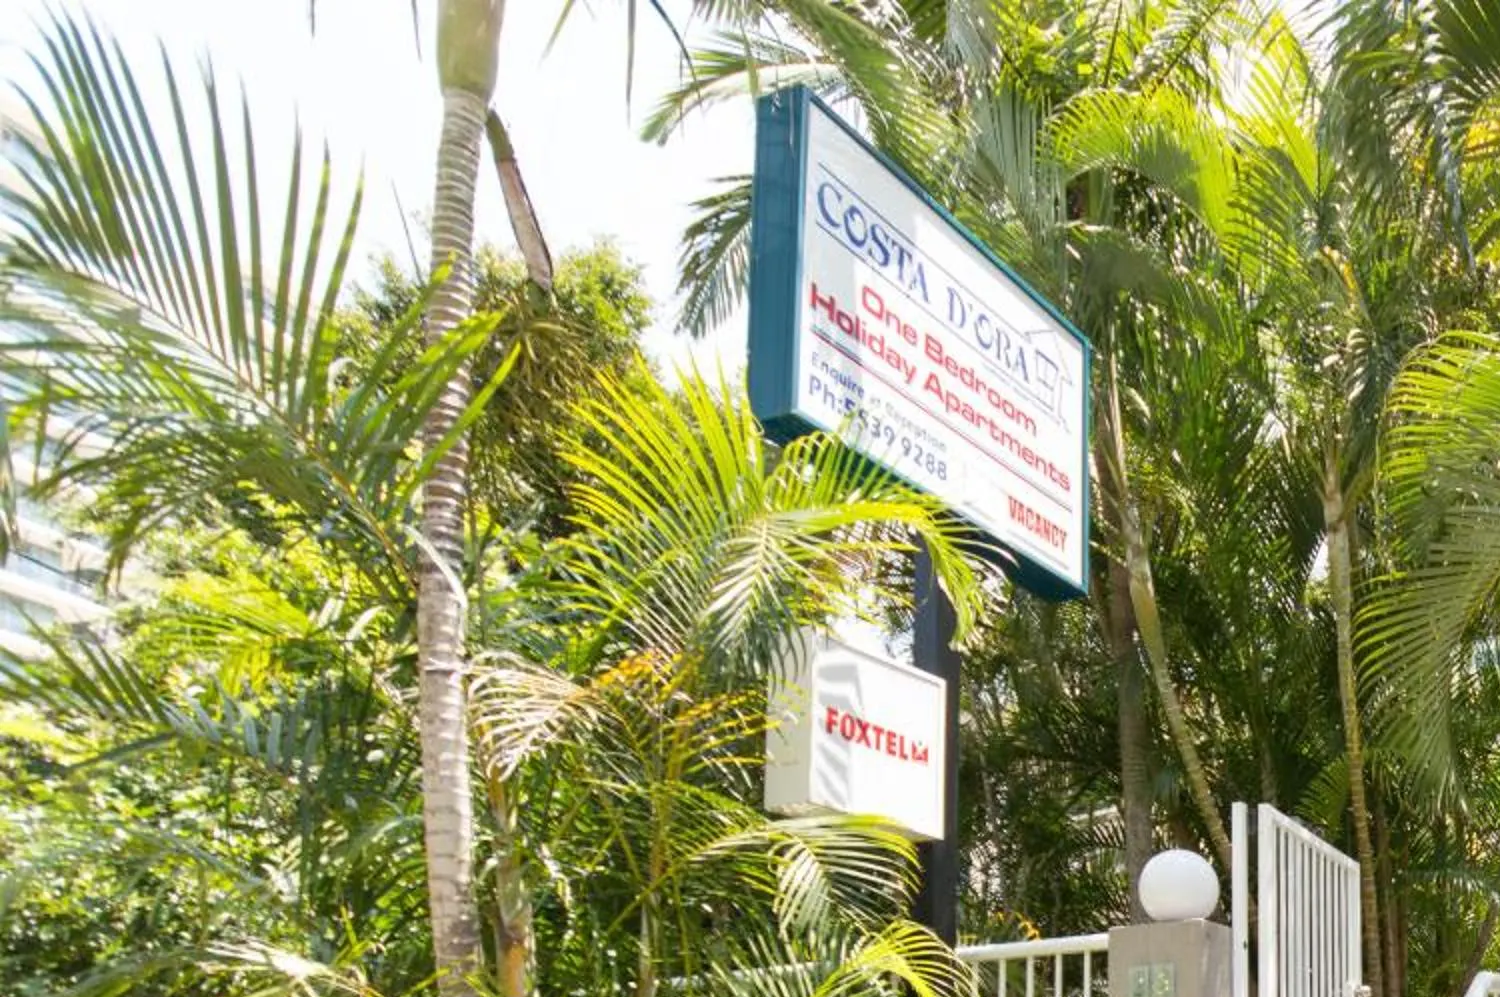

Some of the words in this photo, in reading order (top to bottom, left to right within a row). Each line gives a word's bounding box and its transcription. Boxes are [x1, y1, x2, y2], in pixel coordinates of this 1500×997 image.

[817, 182, 930, 303] COSTA
[947, 286, 1030, 385] D'ORA
[810, 281, 917, 385] Holiday
[923, 371, 1070, 492] Apartments
[811, 351, 864, 396] Enquire
[862, 285, 918, 347] One
[924, 333, 1037, 437] Bedroom
[901, 436, 947, 481] 9288
[1007, 495, 1067, 552] VACANCY
[825, 705, 908, 760] FOXTEL
